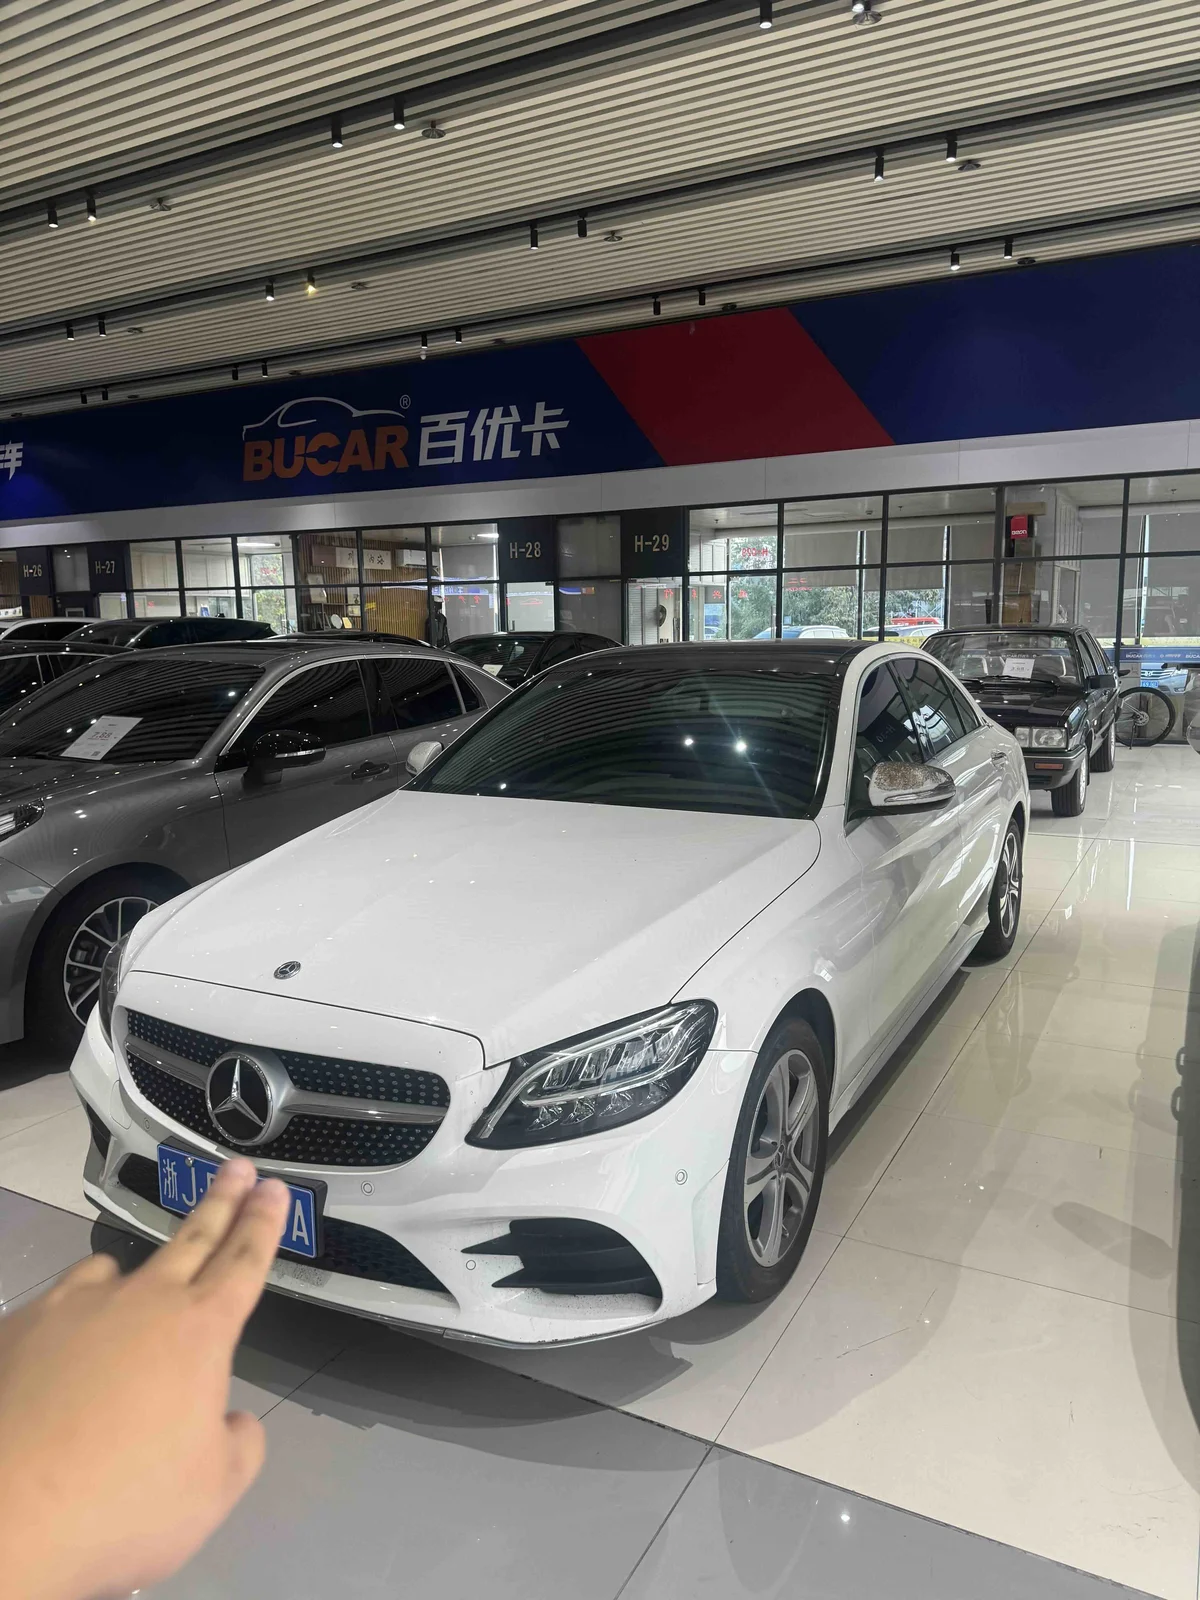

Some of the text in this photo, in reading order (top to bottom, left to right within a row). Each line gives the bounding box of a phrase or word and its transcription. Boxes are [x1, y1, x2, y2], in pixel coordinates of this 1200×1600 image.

[243, 401, 570, 482] BUCAR 百优卡
[509, 541, 541, 559] H-28
[634, 534, 670, 553] H-29
[23, 564, 43, 578] H-26
[95, 560, 115, 574] H-27
